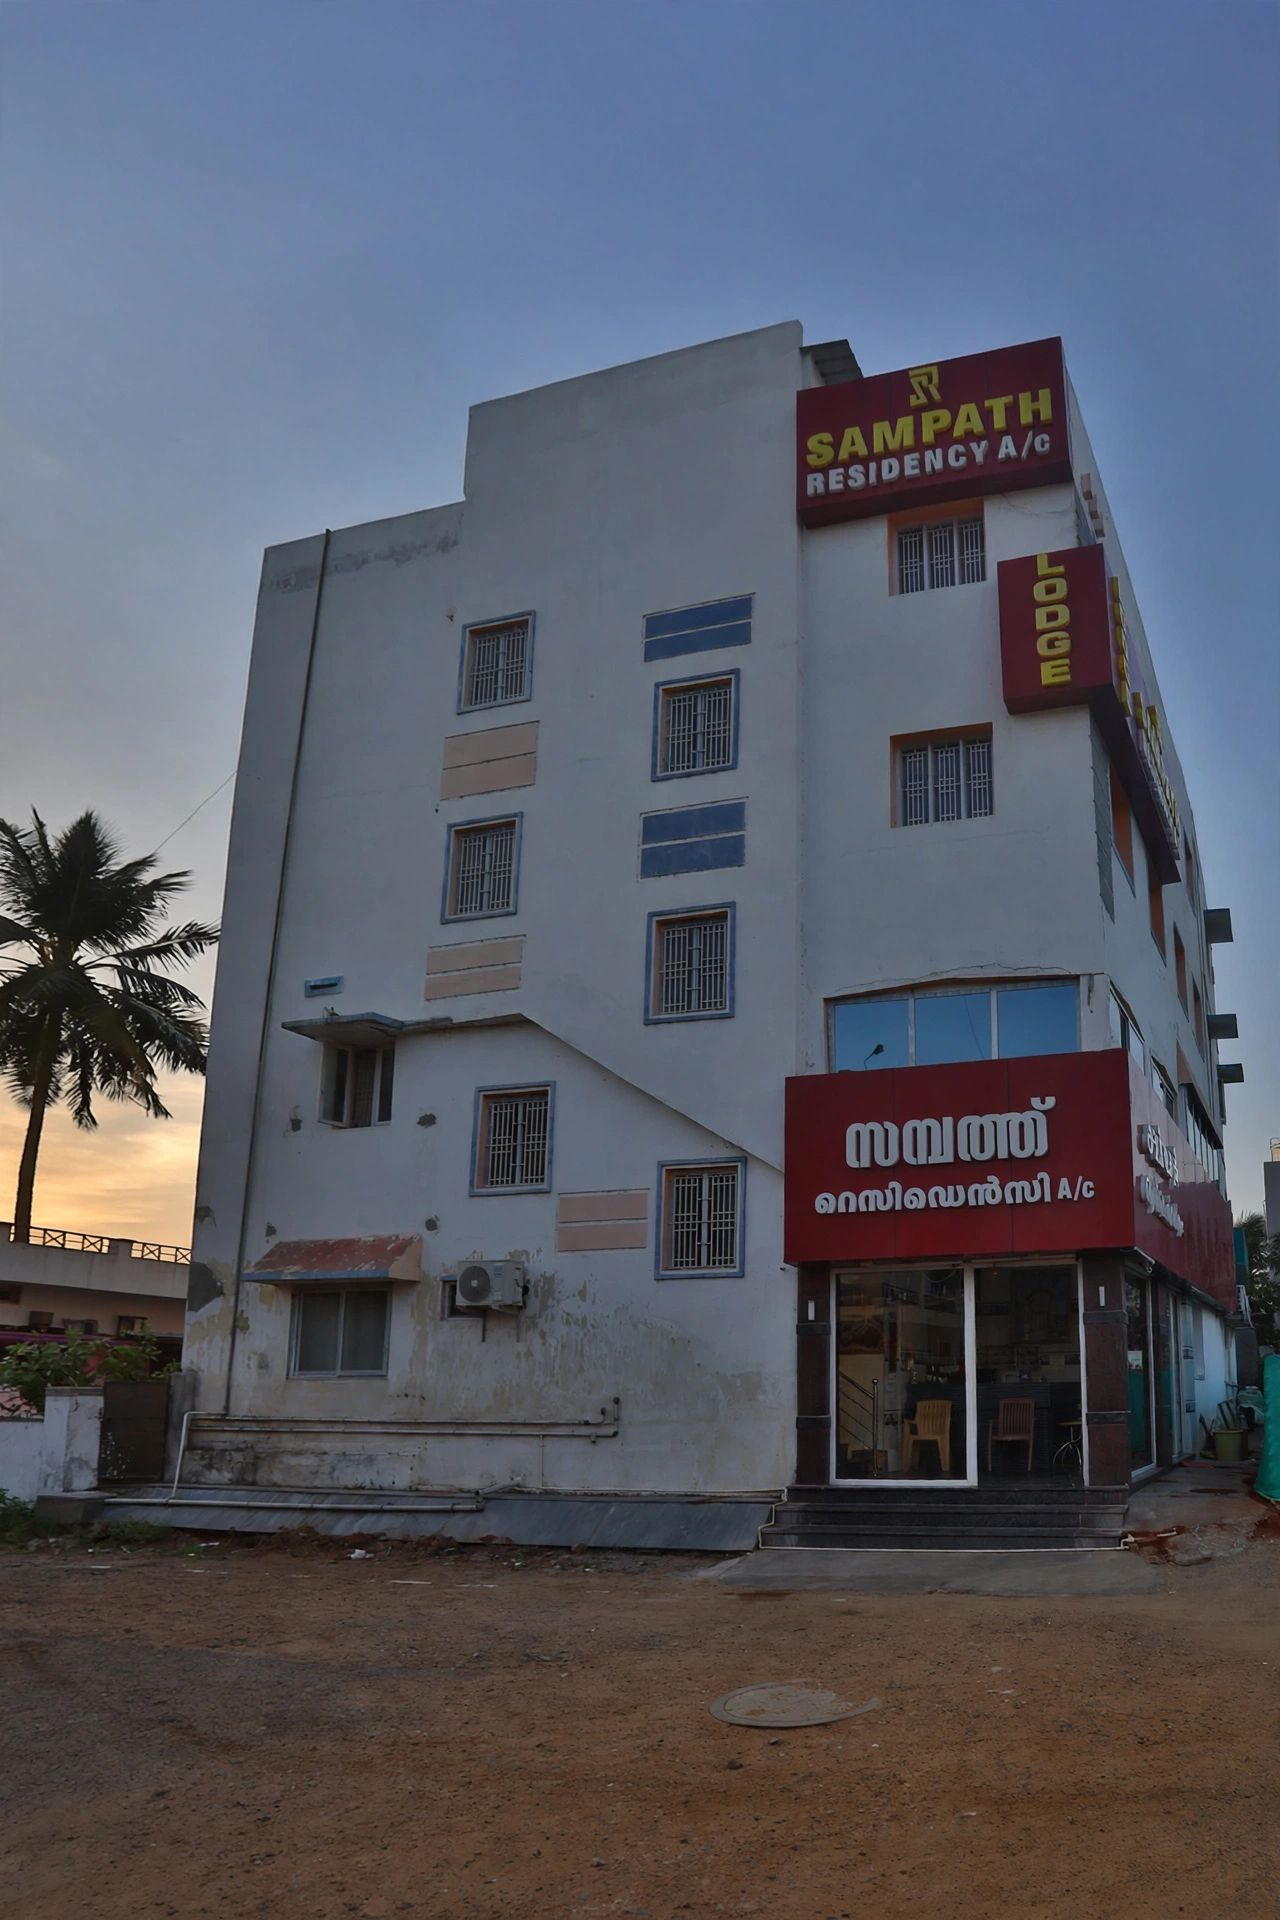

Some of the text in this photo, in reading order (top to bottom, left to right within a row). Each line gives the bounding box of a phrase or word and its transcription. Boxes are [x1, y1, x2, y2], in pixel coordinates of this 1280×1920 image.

[806, 387, 1052, 469] SAMPATH
[806, 430, 1051, 497] RESIDENCY A/C
[1033, 552, 1072, 687] LODGE
[845, 1096, 1056, 1169] സമ്പത്ത്
[1057, 1176, 1095, 1201] A/C
